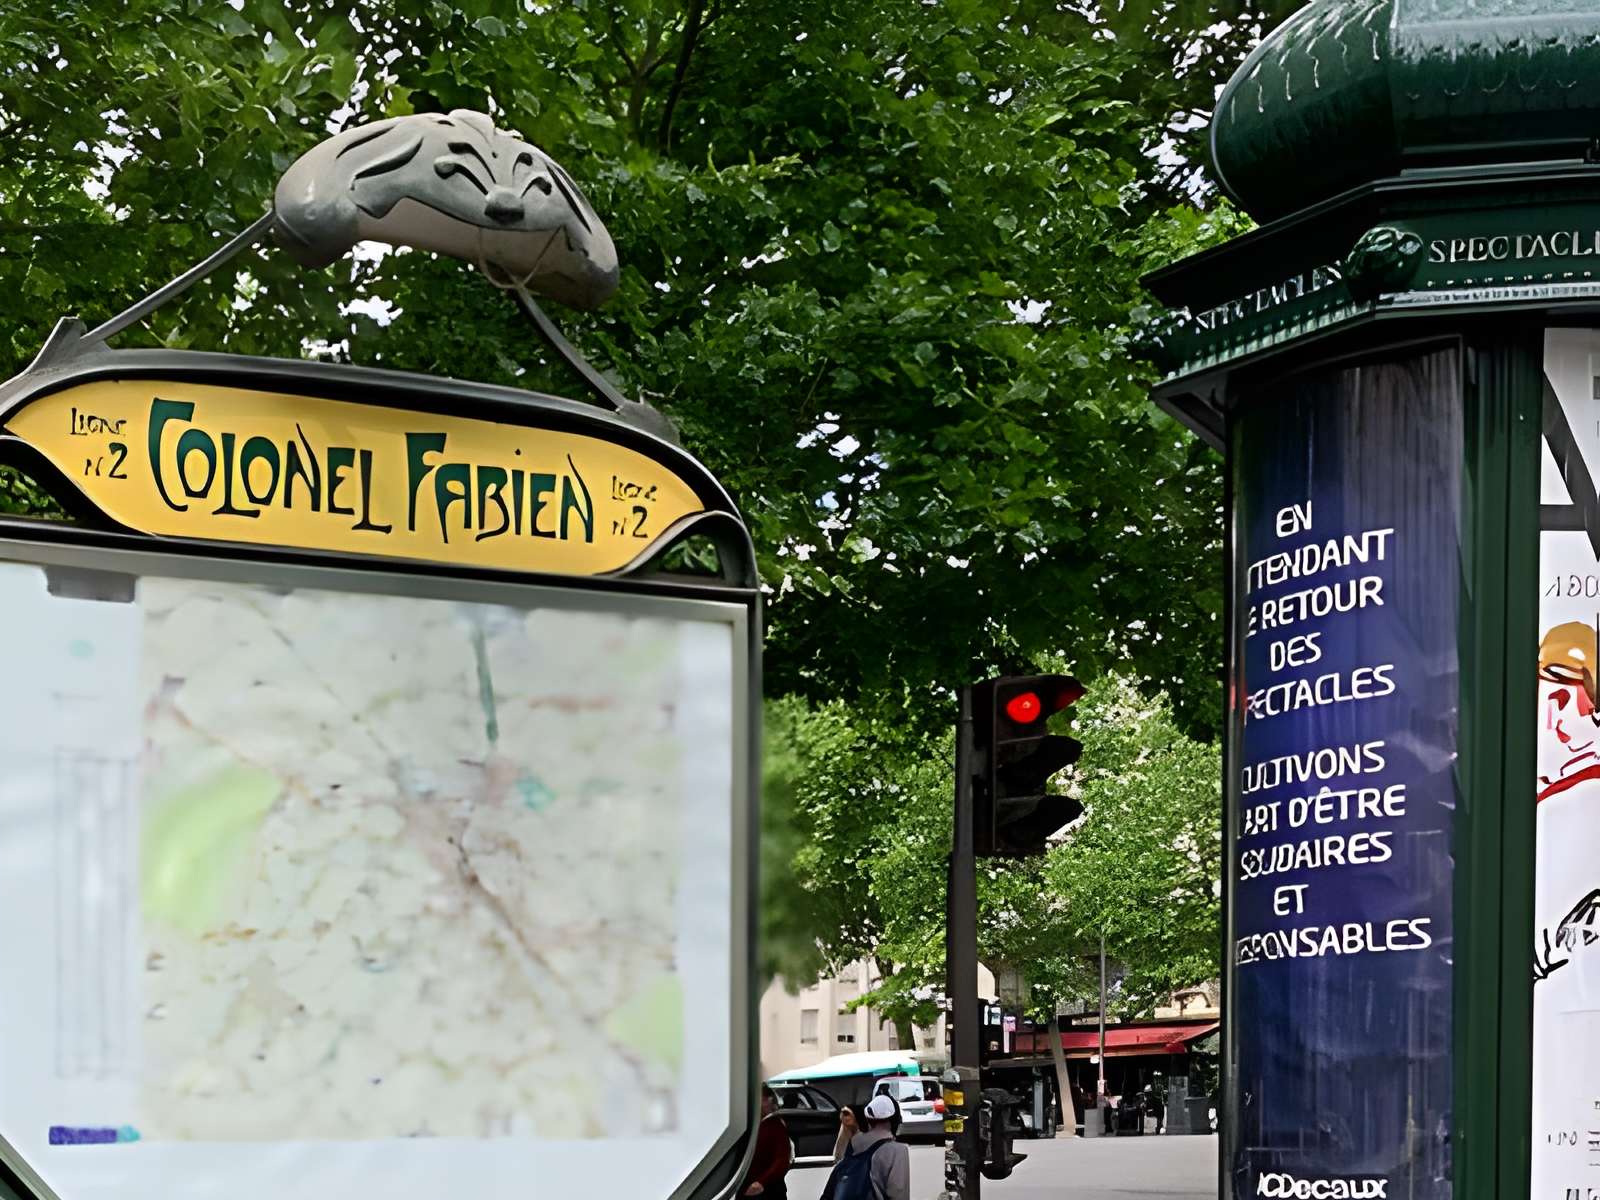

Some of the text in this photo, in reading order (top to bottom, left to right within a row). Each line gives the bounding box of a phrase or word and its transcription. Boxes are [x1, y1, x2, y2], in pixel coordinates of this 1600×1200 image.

[148, 397, 594, 544] COLONEL FABIEN
[1276, 500, 1312, 538] EN
[1262, 576, 1385, 630] RETOUR
[1270, 632, 1322, 672] DES
[1289, 786, 1406, 829] D'ÊTRE
[1273, 884, 1310, 916] ET
